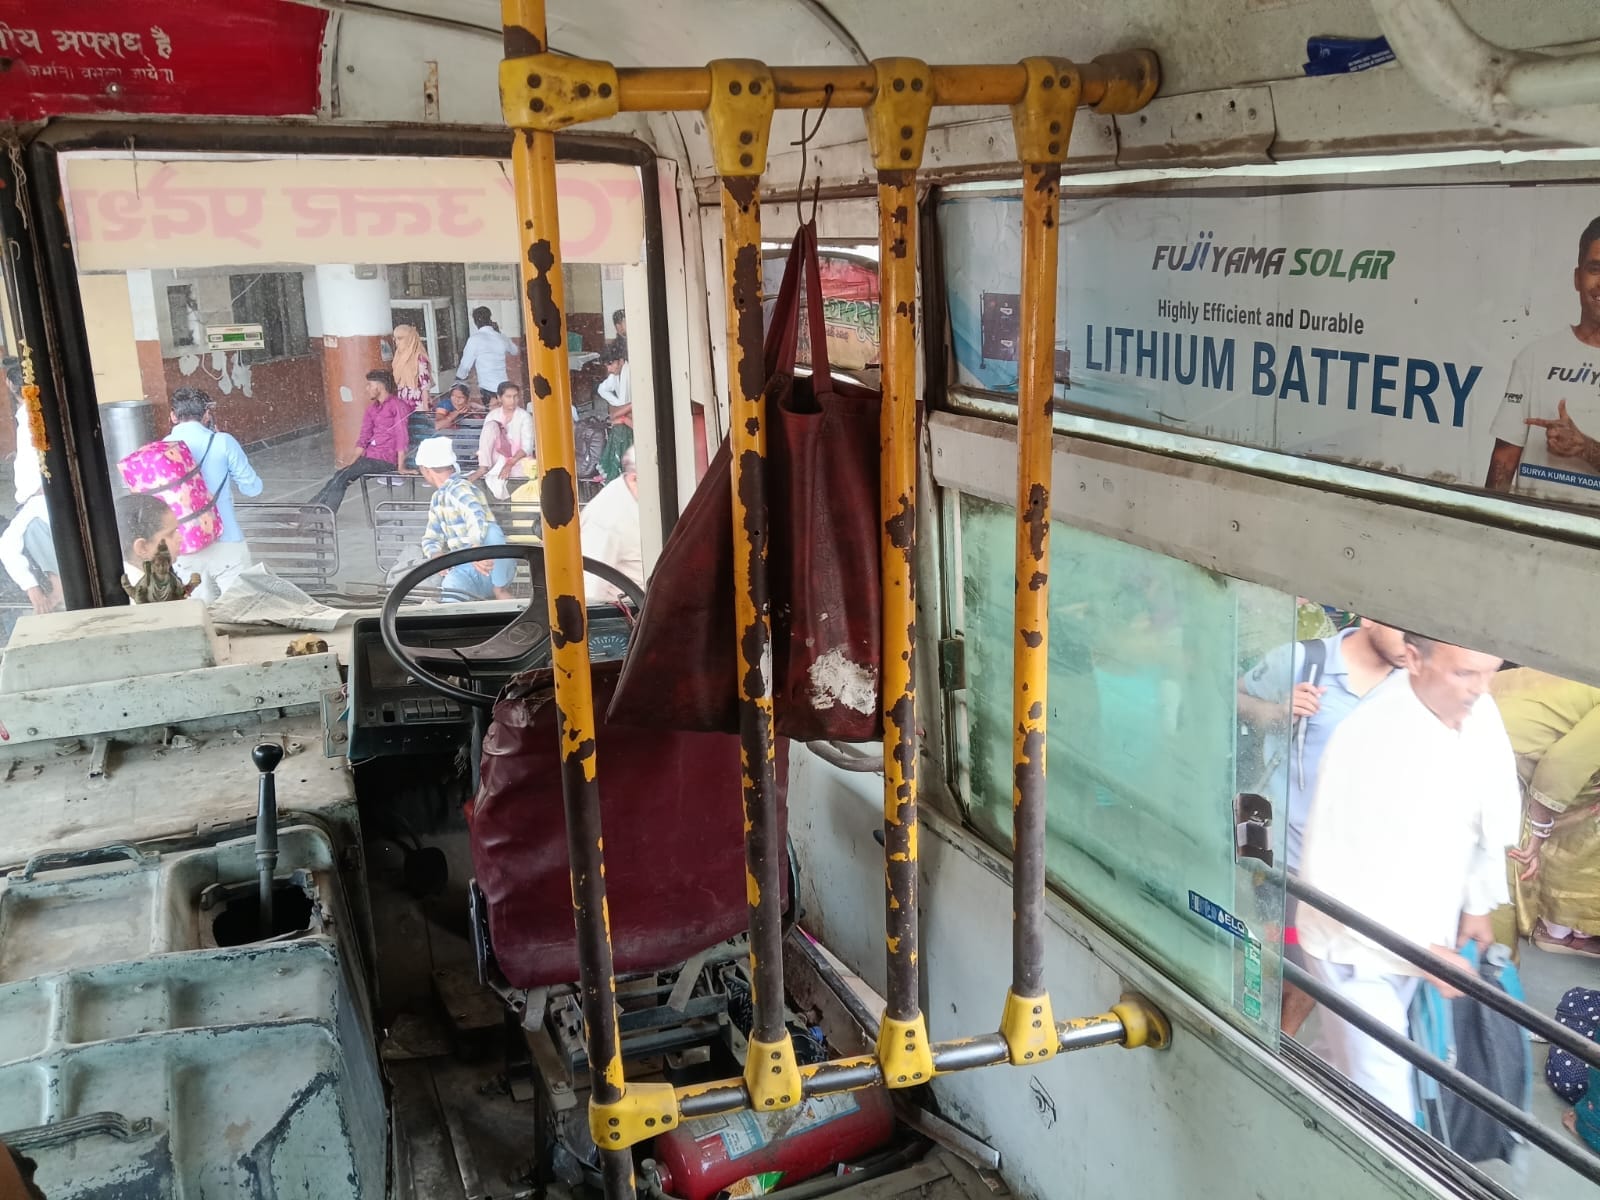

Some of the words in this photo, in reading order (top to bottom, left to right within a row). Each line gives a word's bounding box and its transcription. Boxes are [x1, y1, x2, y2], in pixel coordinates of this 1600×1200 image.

[52, 29, 151, 61] अपराध
[150, 25, 173, 59] है
[1288, 247, 1396, 283] SOLAR
[1157, 298, 1200, 325] Highly
[1203, 302, 1262, 327] Efficient
[1266, 308, 1293, 329] and
[1299, 309, 1364, 335] Durable
[1086, 324, 1235, 392] LITHIUM
[1252, 340, 1484, 428] BATTERY
[1521, 465, 1546, 478] SURYA
[1547, 471, 1577, 484] KUMAR
